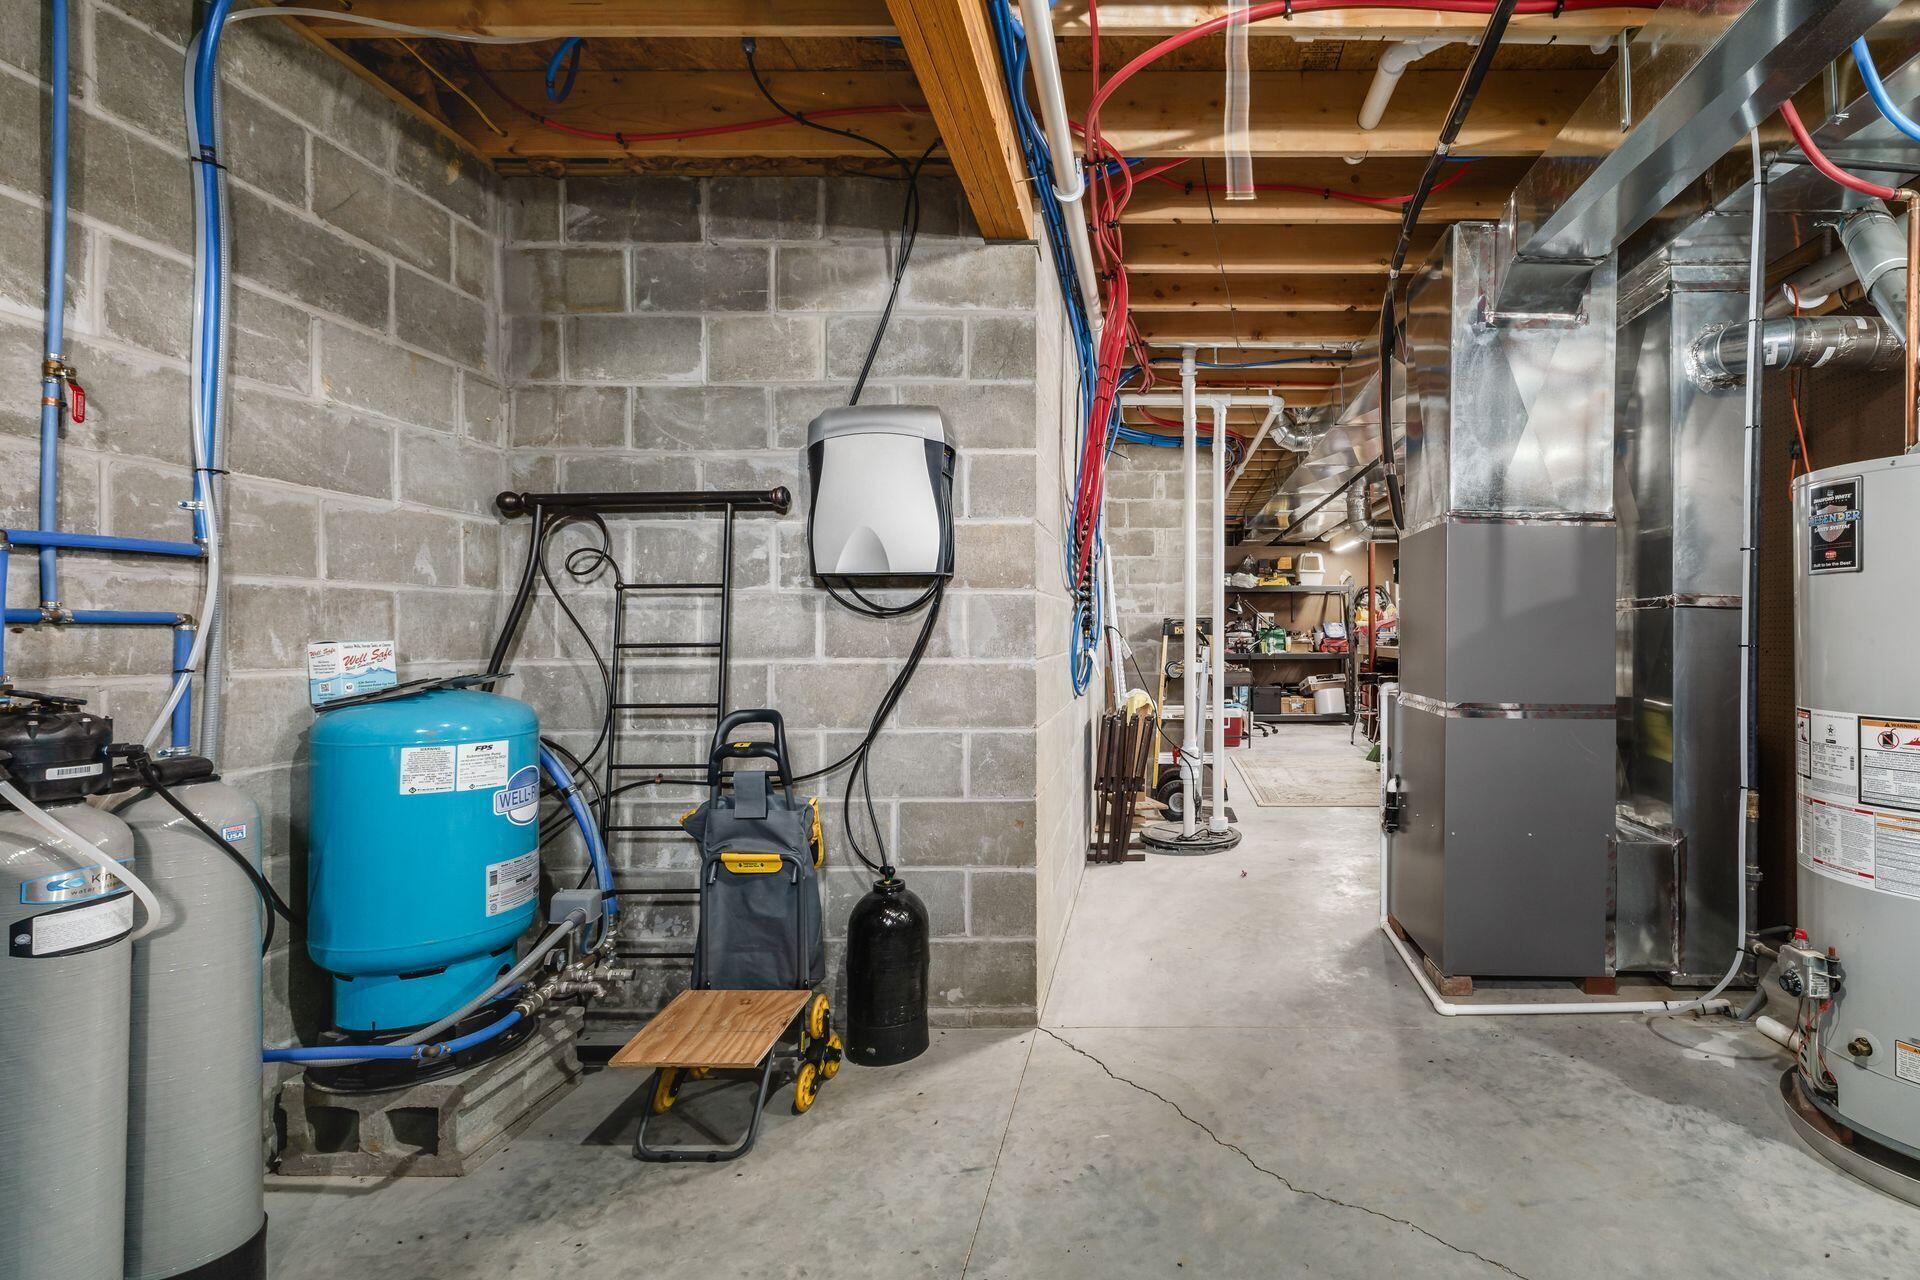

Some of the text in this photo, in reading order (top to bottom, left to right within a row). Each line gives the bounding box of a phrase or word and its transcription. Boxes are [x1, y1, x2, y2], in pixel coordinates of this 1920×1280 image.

[343, 647, 393, 667] Well Safe
[226, 832, 243, 840] USA
[70, 887, 95, 896] water
